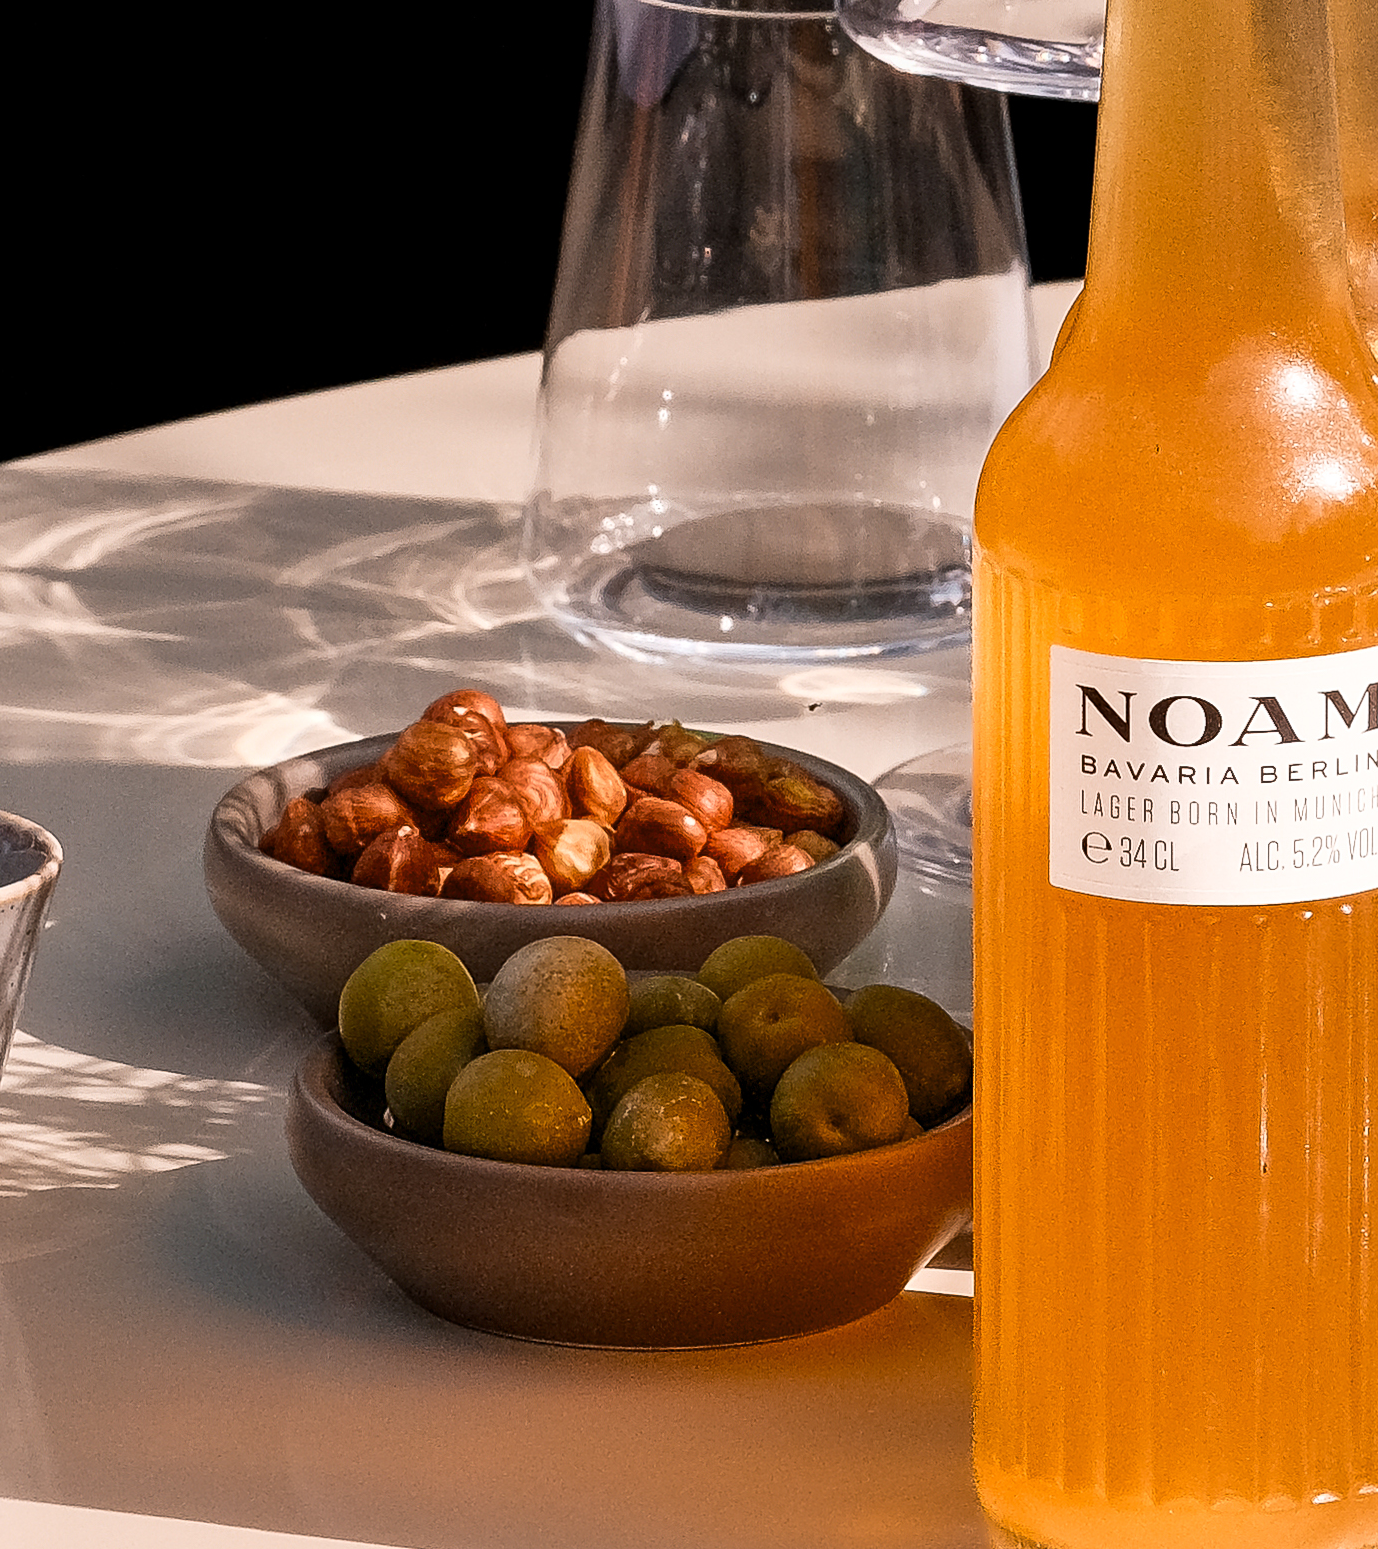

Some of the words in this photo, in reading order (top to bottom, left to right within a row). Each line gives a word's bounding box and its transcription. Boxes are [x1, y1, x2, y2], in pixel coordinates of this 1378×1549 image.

[1081, 754, 1239, 784] BAVARIA
[1081, 789, 1154, 824] LAGER
[1170, 799, 1238, 826] BORN
[1255, 799, 1278, 826] IN
[1292, 834, 1341, 870] 5.2%
